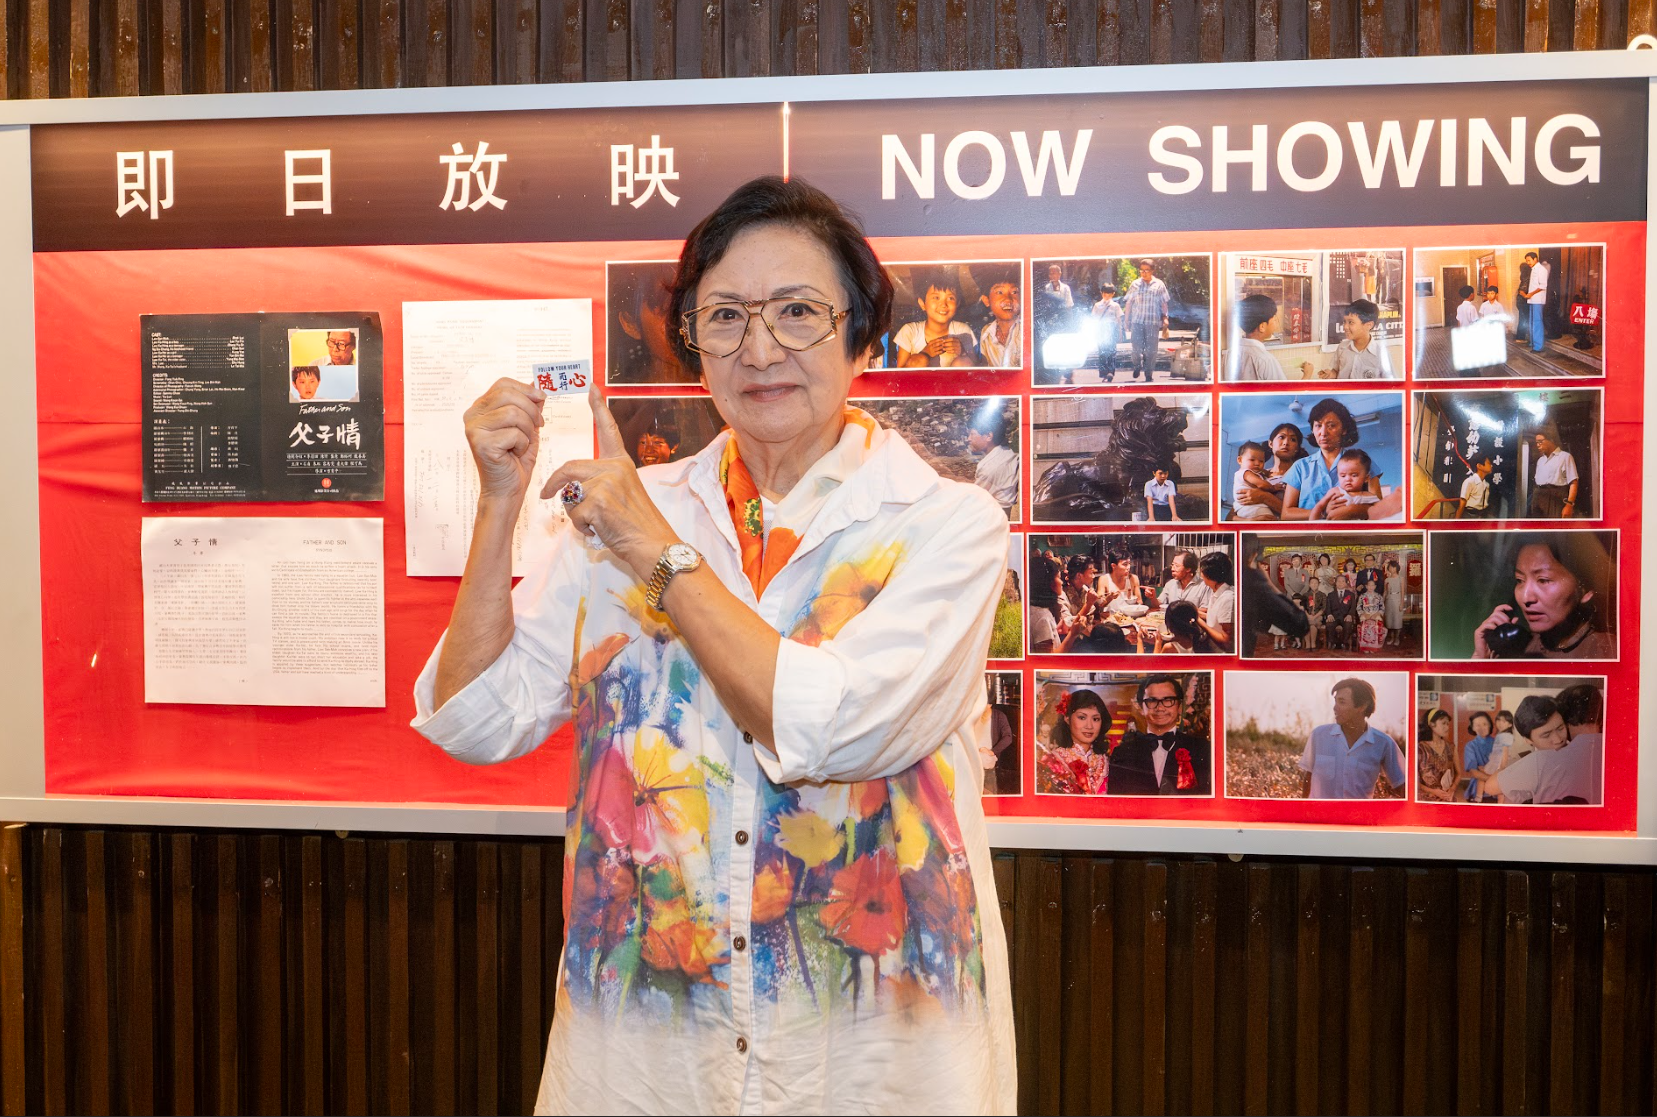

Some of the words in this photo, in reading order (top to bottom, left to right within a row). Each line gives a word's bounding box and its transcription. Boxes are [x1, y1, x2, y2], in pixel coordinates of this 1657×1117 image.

[880, 128, 1093, 201] NOW
[1147, 113, 1603, 195] SHOWING
[115, 134, 680, 220] 即日放映
[1239, 257, 1274, 272] 前座四毛
[1280, 260, 1308, 274] 中座七毛
[298, 403, 321, 415] Father
[321, 404, 337, 413] and
[336, 403, 351, 413] Son
[288, 417, 361, 451] 父子情
[173, 537, 218, 547] 父子情
